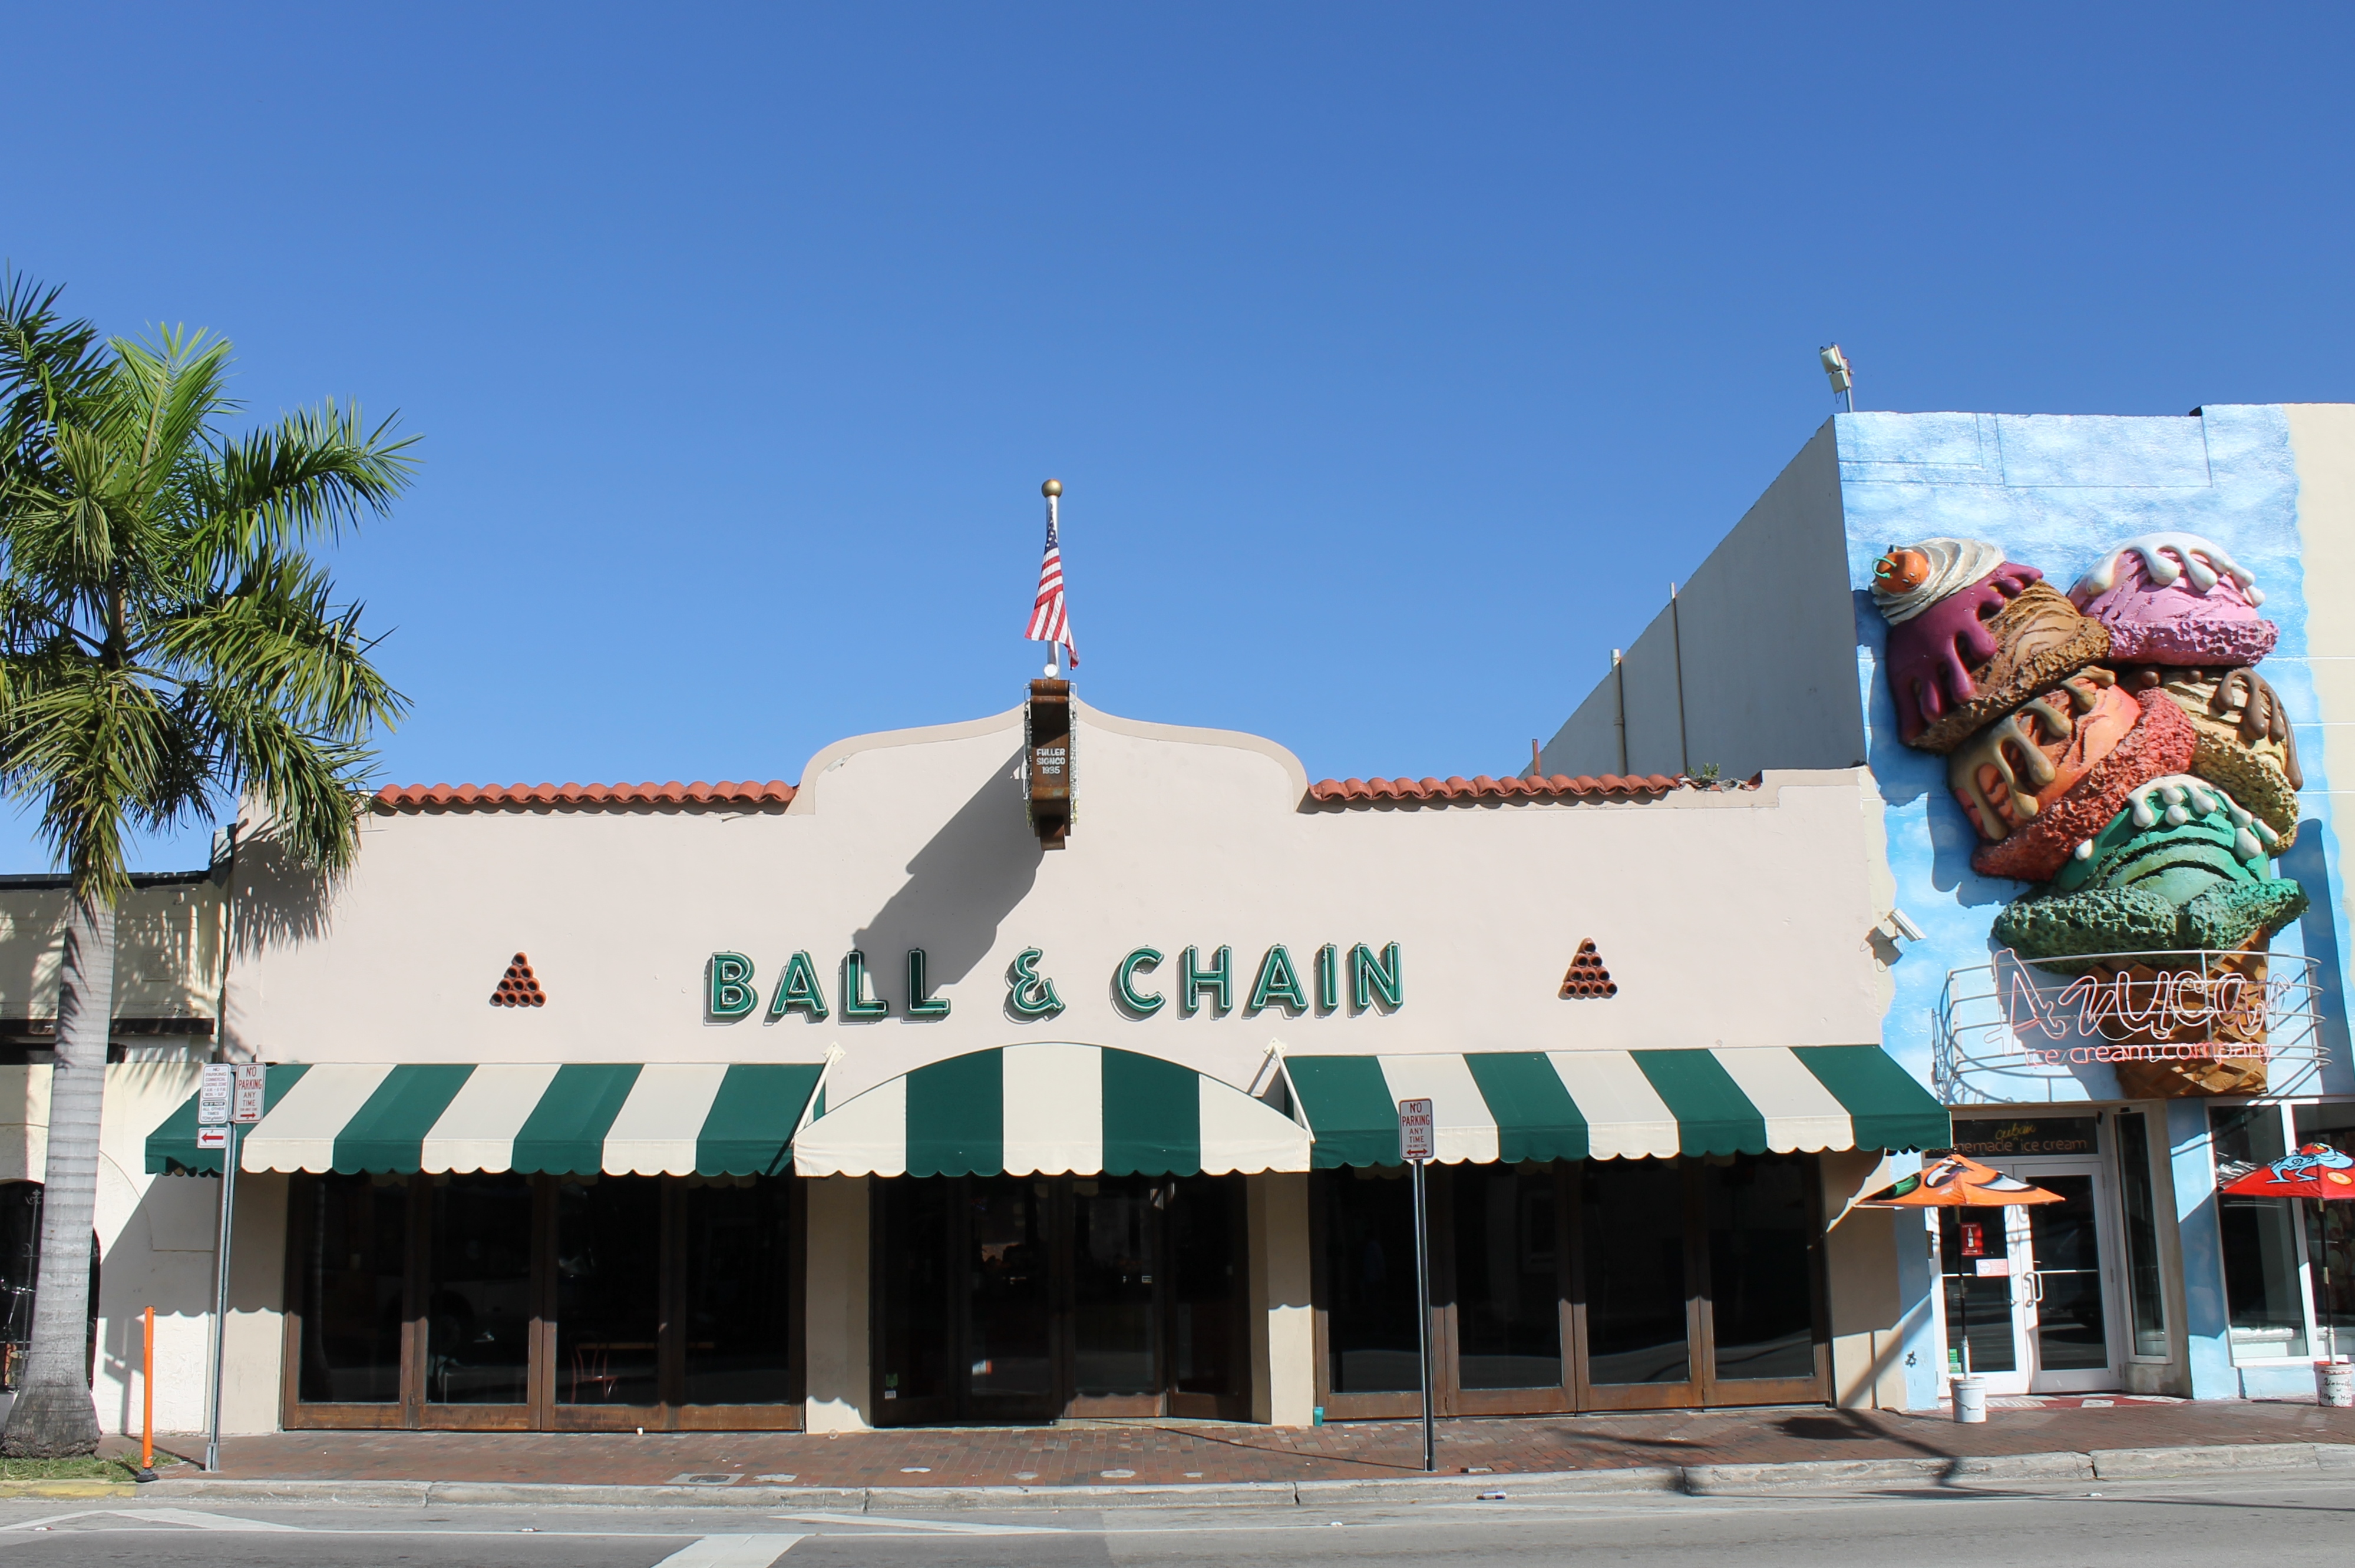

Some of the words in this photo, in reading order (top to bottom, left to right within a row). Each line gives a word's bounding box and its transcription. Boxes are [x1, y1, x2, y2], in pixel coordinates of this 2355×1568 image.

[1036, 748, 1065, 756] FULLER
[1042, 766, 1061, 775] 1935
[711, 949, 951, 1016] BALL
[1012, 947, 1065, 1015] &
[1118, 941, 1403, 1013] CHAIN
[1984, 948, 2291, 1056] Azucar
[2024, 1048, 2060, 1067] ice
[2070, 1044, 2158, 1064] cream
[2161, 1041, 2272, 1065] company
[246, 1066, 257, 1077] NO
[239, 1079, 262, 1090] PARKING
[1410, 1102, 1422, 1113] NO
[1402, 1114, 1430, 1126] PARKING
[2020, 1138, 2040, 1152] ice
[2043, 1139, 2088, 1151] cream
